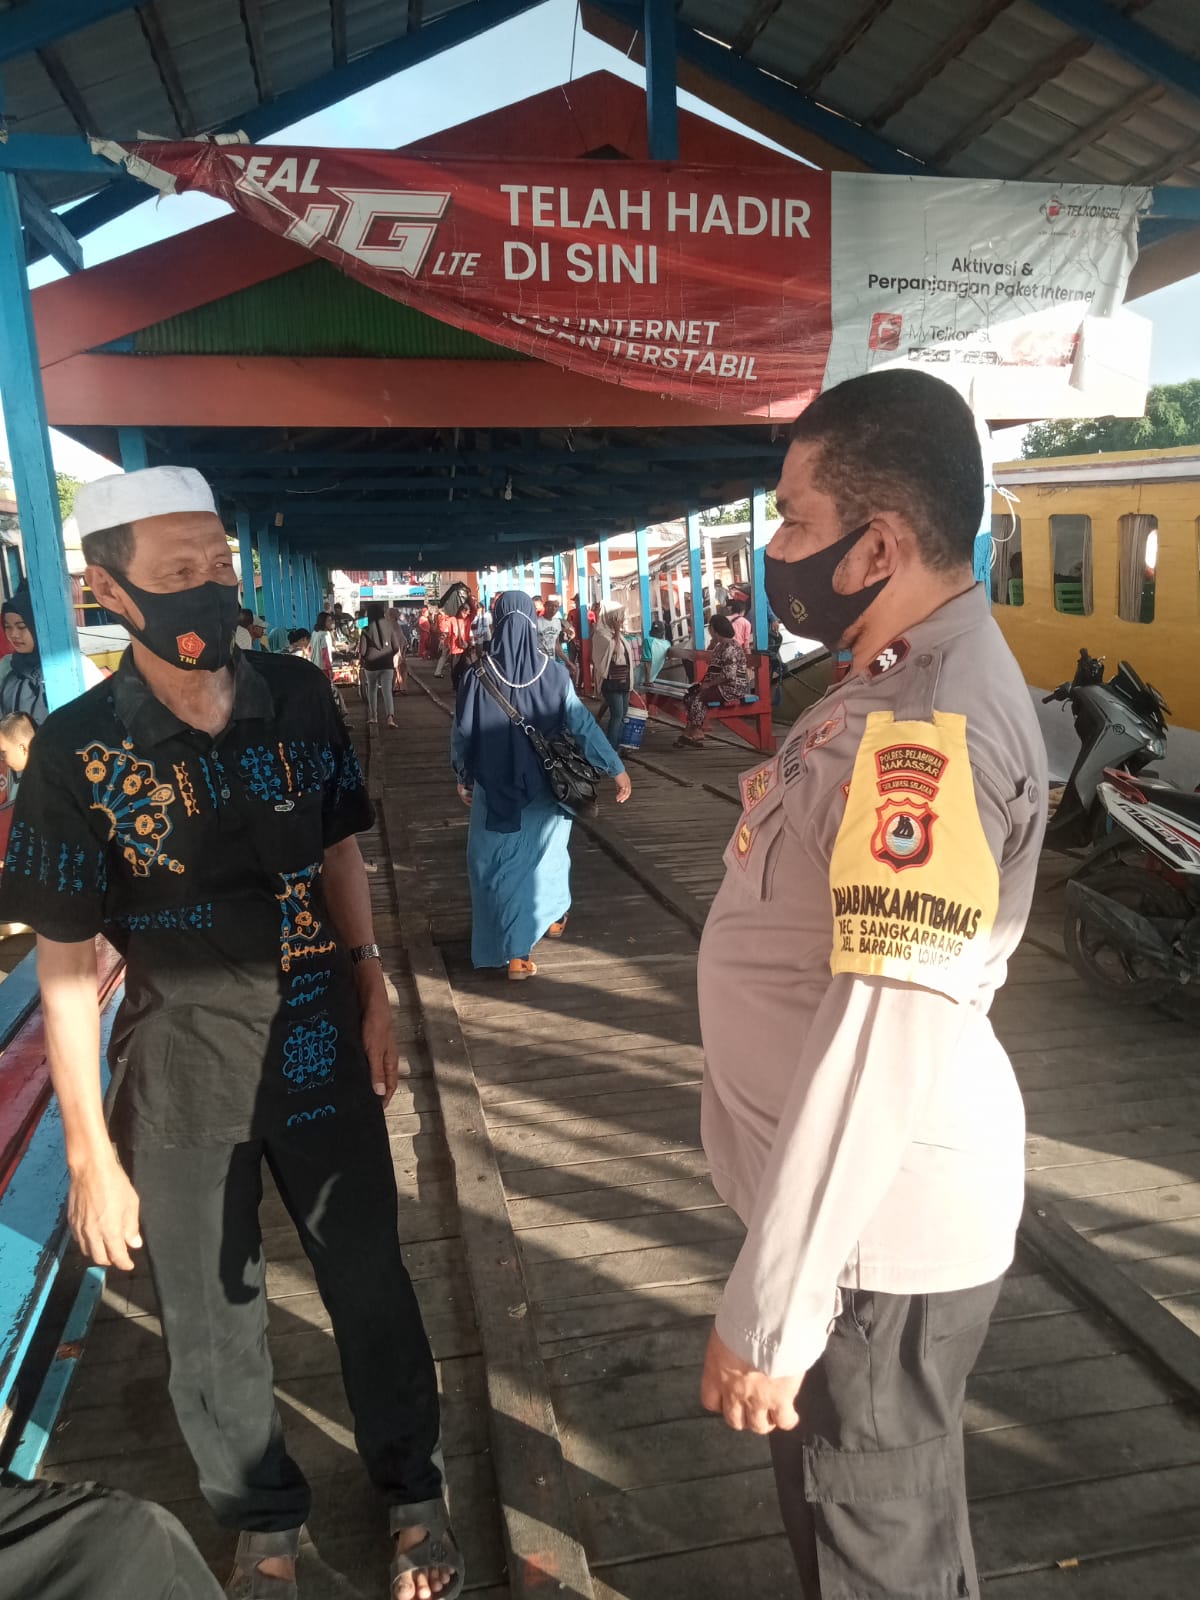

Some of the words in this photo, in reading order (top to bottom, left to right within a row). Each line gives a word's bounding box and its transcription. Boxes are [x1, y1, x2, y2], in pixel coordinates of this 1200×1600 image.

[500, 184, 650, 230] TELAH
[667, 191, 811, 238] HADIR
[432, 252, 481, 276] LTE
[503, 241, 550, 281] DI
[566, 243, 658, 284] SINI
[951, 257, 1017, 277] Aktivasi
[1021, 262, 1034, 277] &
[868, 274, 990, 299] Perpanjangan
[994, 281, 1038, 298] Paket
[579, 318, 720, 346] INTERNET
[610, 336, 758, 381] TERSTABIL
[179, 654, 196, 665] TNI
[881, 760, 939, 777] MAKASSAR
[858, 937, 912, 961] BARRANG
[860, 919, 964, 957] SANGKARRANG
